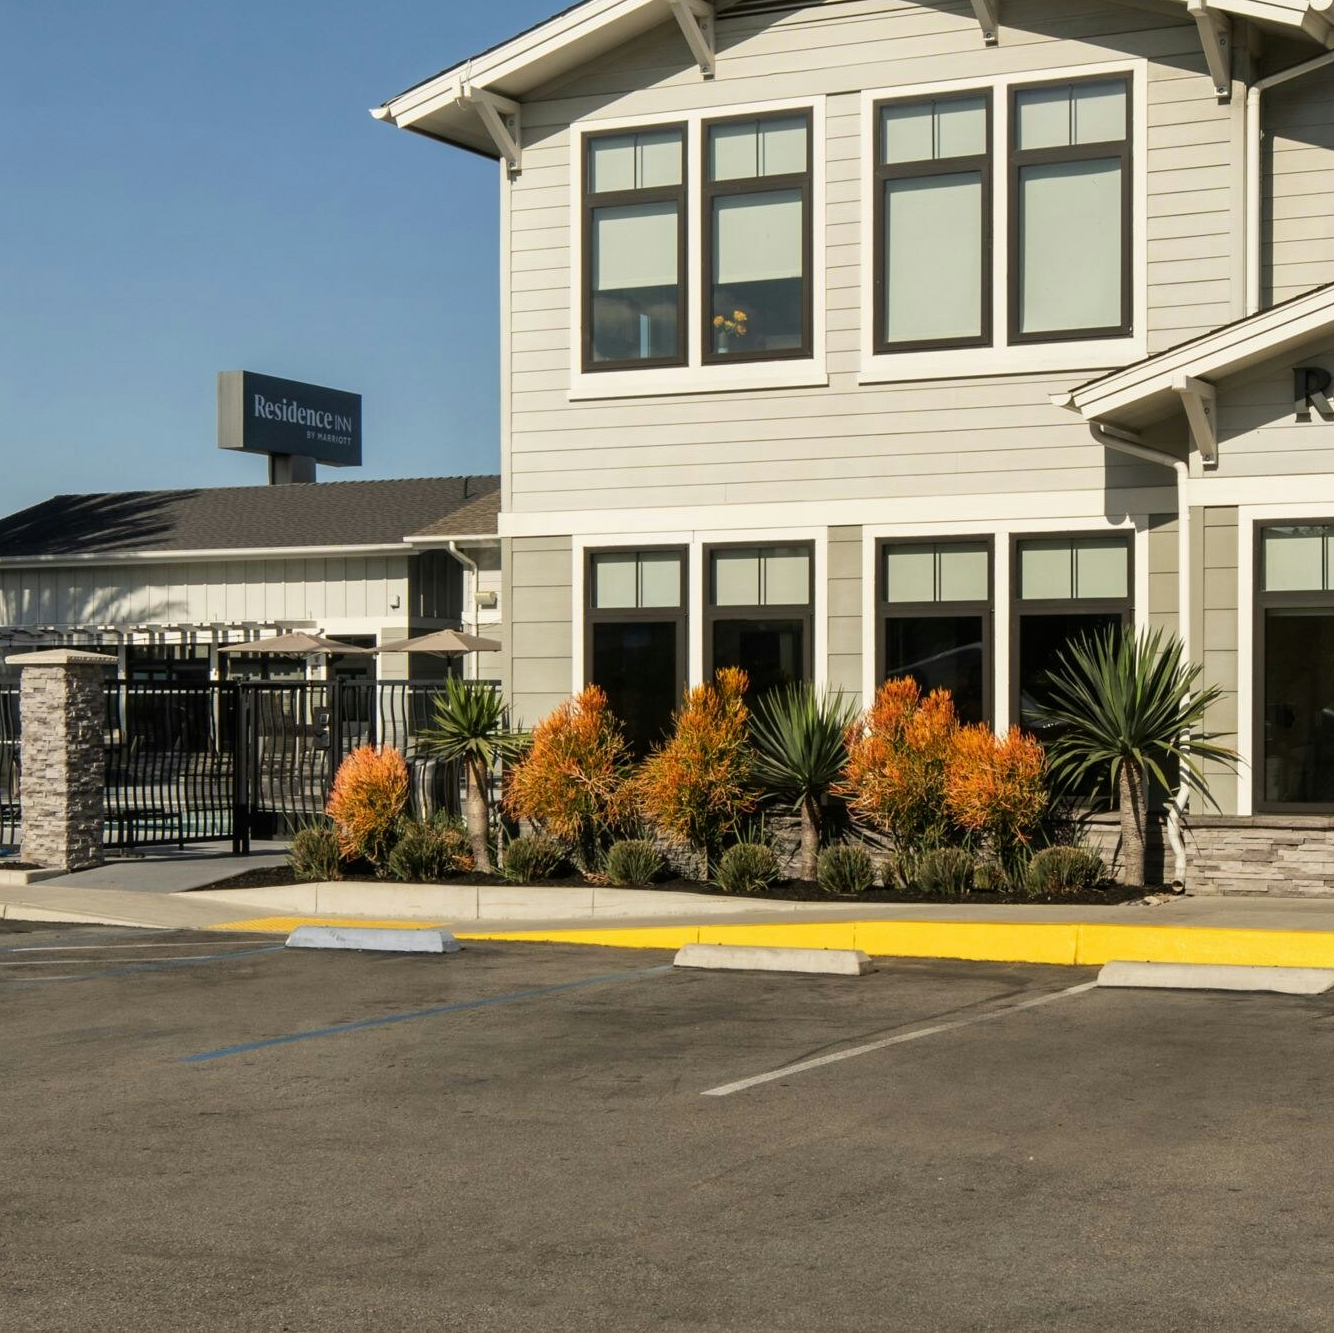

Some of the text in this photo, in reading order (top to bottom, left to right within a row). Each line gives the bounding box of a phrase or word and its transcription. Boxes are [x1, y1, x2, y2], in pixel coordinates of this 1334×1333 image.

[254, 394, 353, 433] Residence INN
[306, 430, 352, 445] BY MARRIOTT
